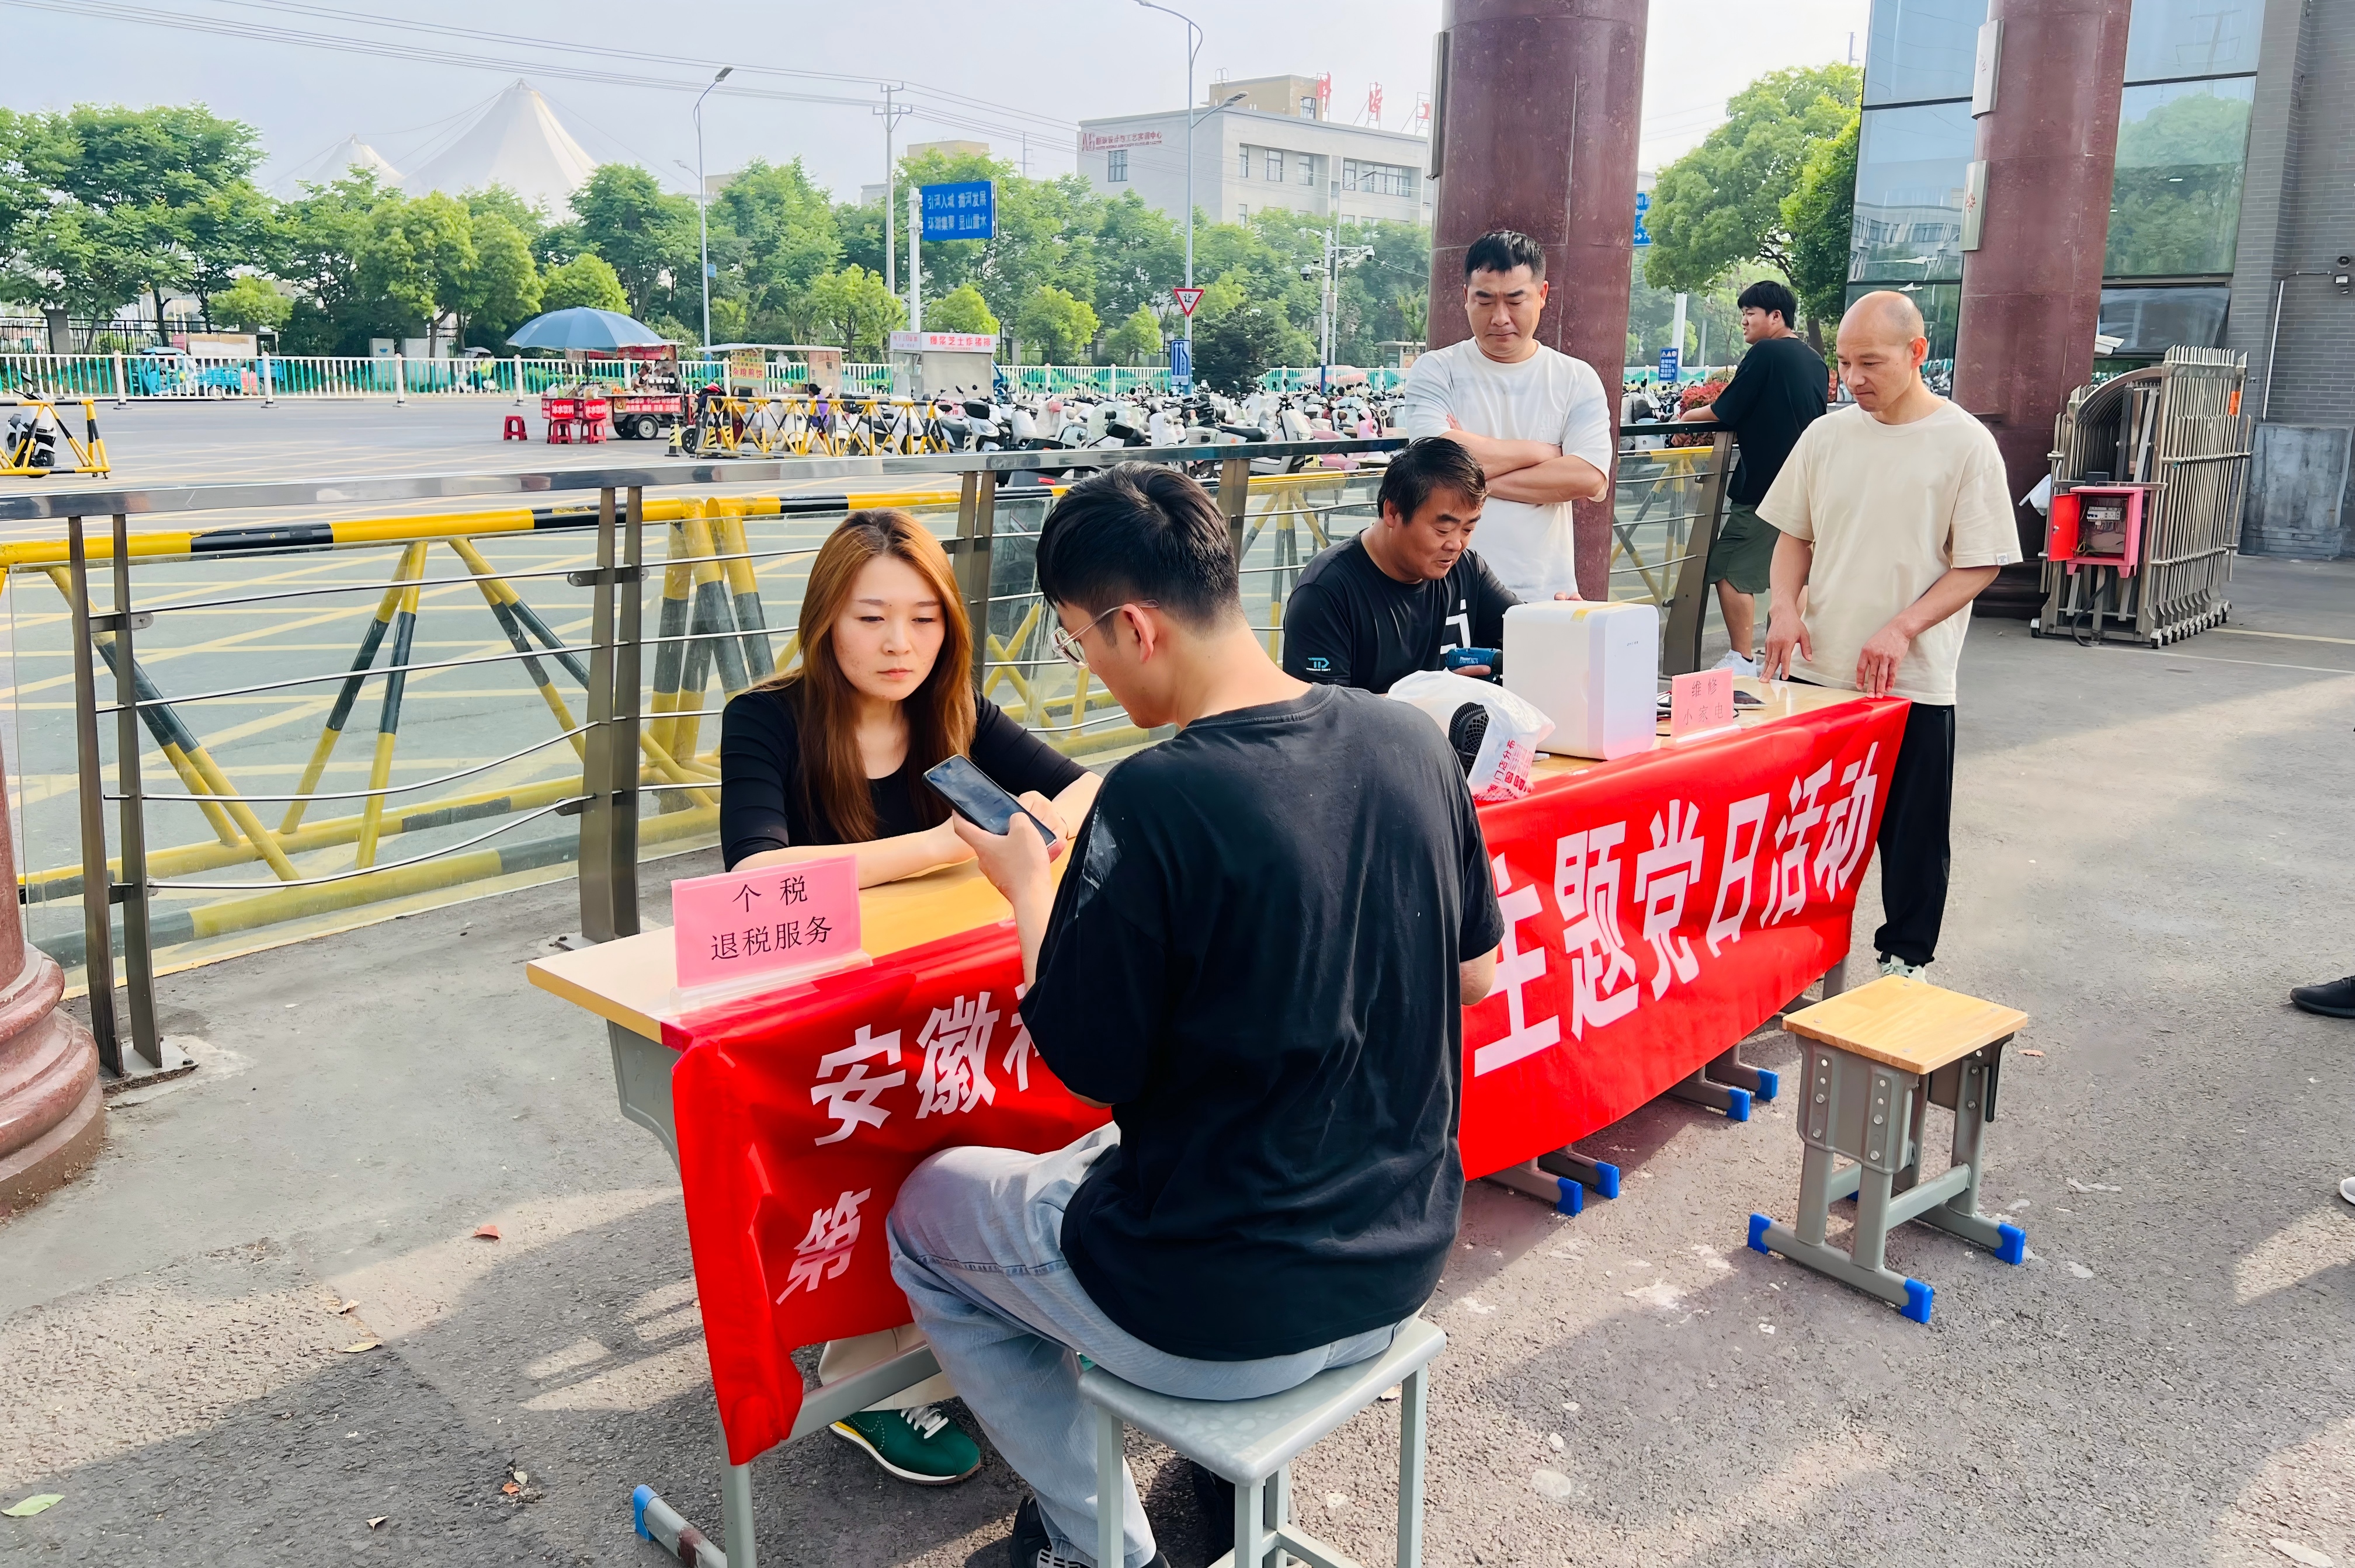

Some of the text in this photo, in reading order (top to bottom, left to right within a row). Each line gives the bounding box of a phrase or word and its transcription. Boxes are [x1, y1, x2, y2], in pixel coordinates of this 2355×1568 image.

[1183, 293, 1193, 303] 让
[1691, 677, 1717, 698] 维修
[1683, 702, 1724, 725] 小家电
[732, 875, 808, 913] 个税
[1474, 740, 1878, 1078] 主题党日活动
[710, 916, 833, 961] 退税服务
[775, 1187, 871, 1305] 第
